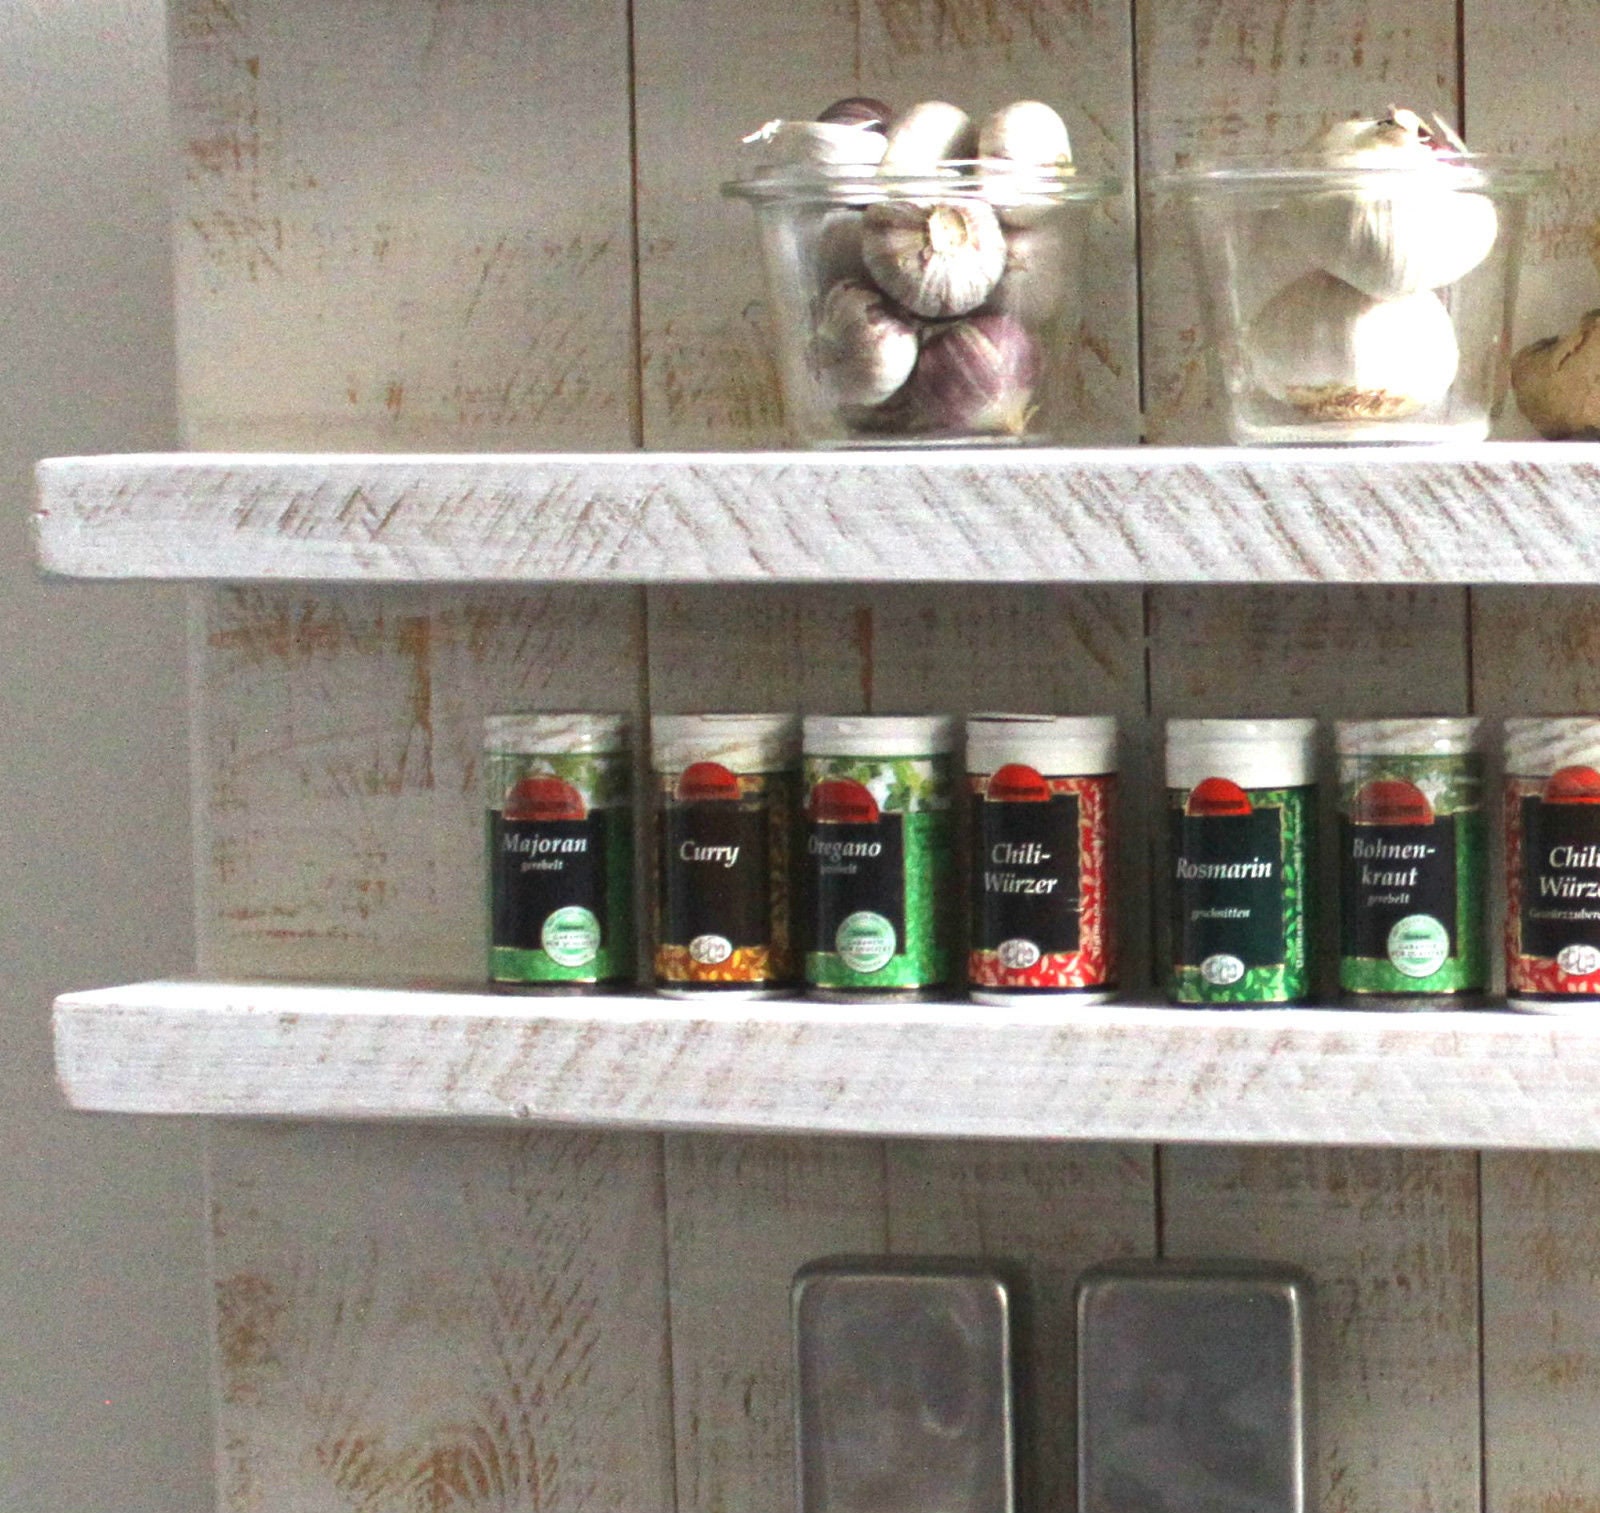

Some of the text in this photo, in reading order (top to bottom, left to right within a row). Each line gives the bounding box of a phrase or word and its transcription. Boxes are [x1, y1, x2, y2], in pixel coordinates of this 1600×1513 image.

[503, 833, 588, 858] Majoran
[680, 841, 740, 868] Curry
[808, 834, 882, 863] Oregano
[991, 844, 1051, 865] Chili-
[1352, 837, 1436, 859] Bohnen-
[1176, 857, 1272, 879] Rosmarin
[1361, 864, 1419, 886] kraut
[984, 871, 1058, 894] Würzer
[1539, 876, 1600, 897] Würz
